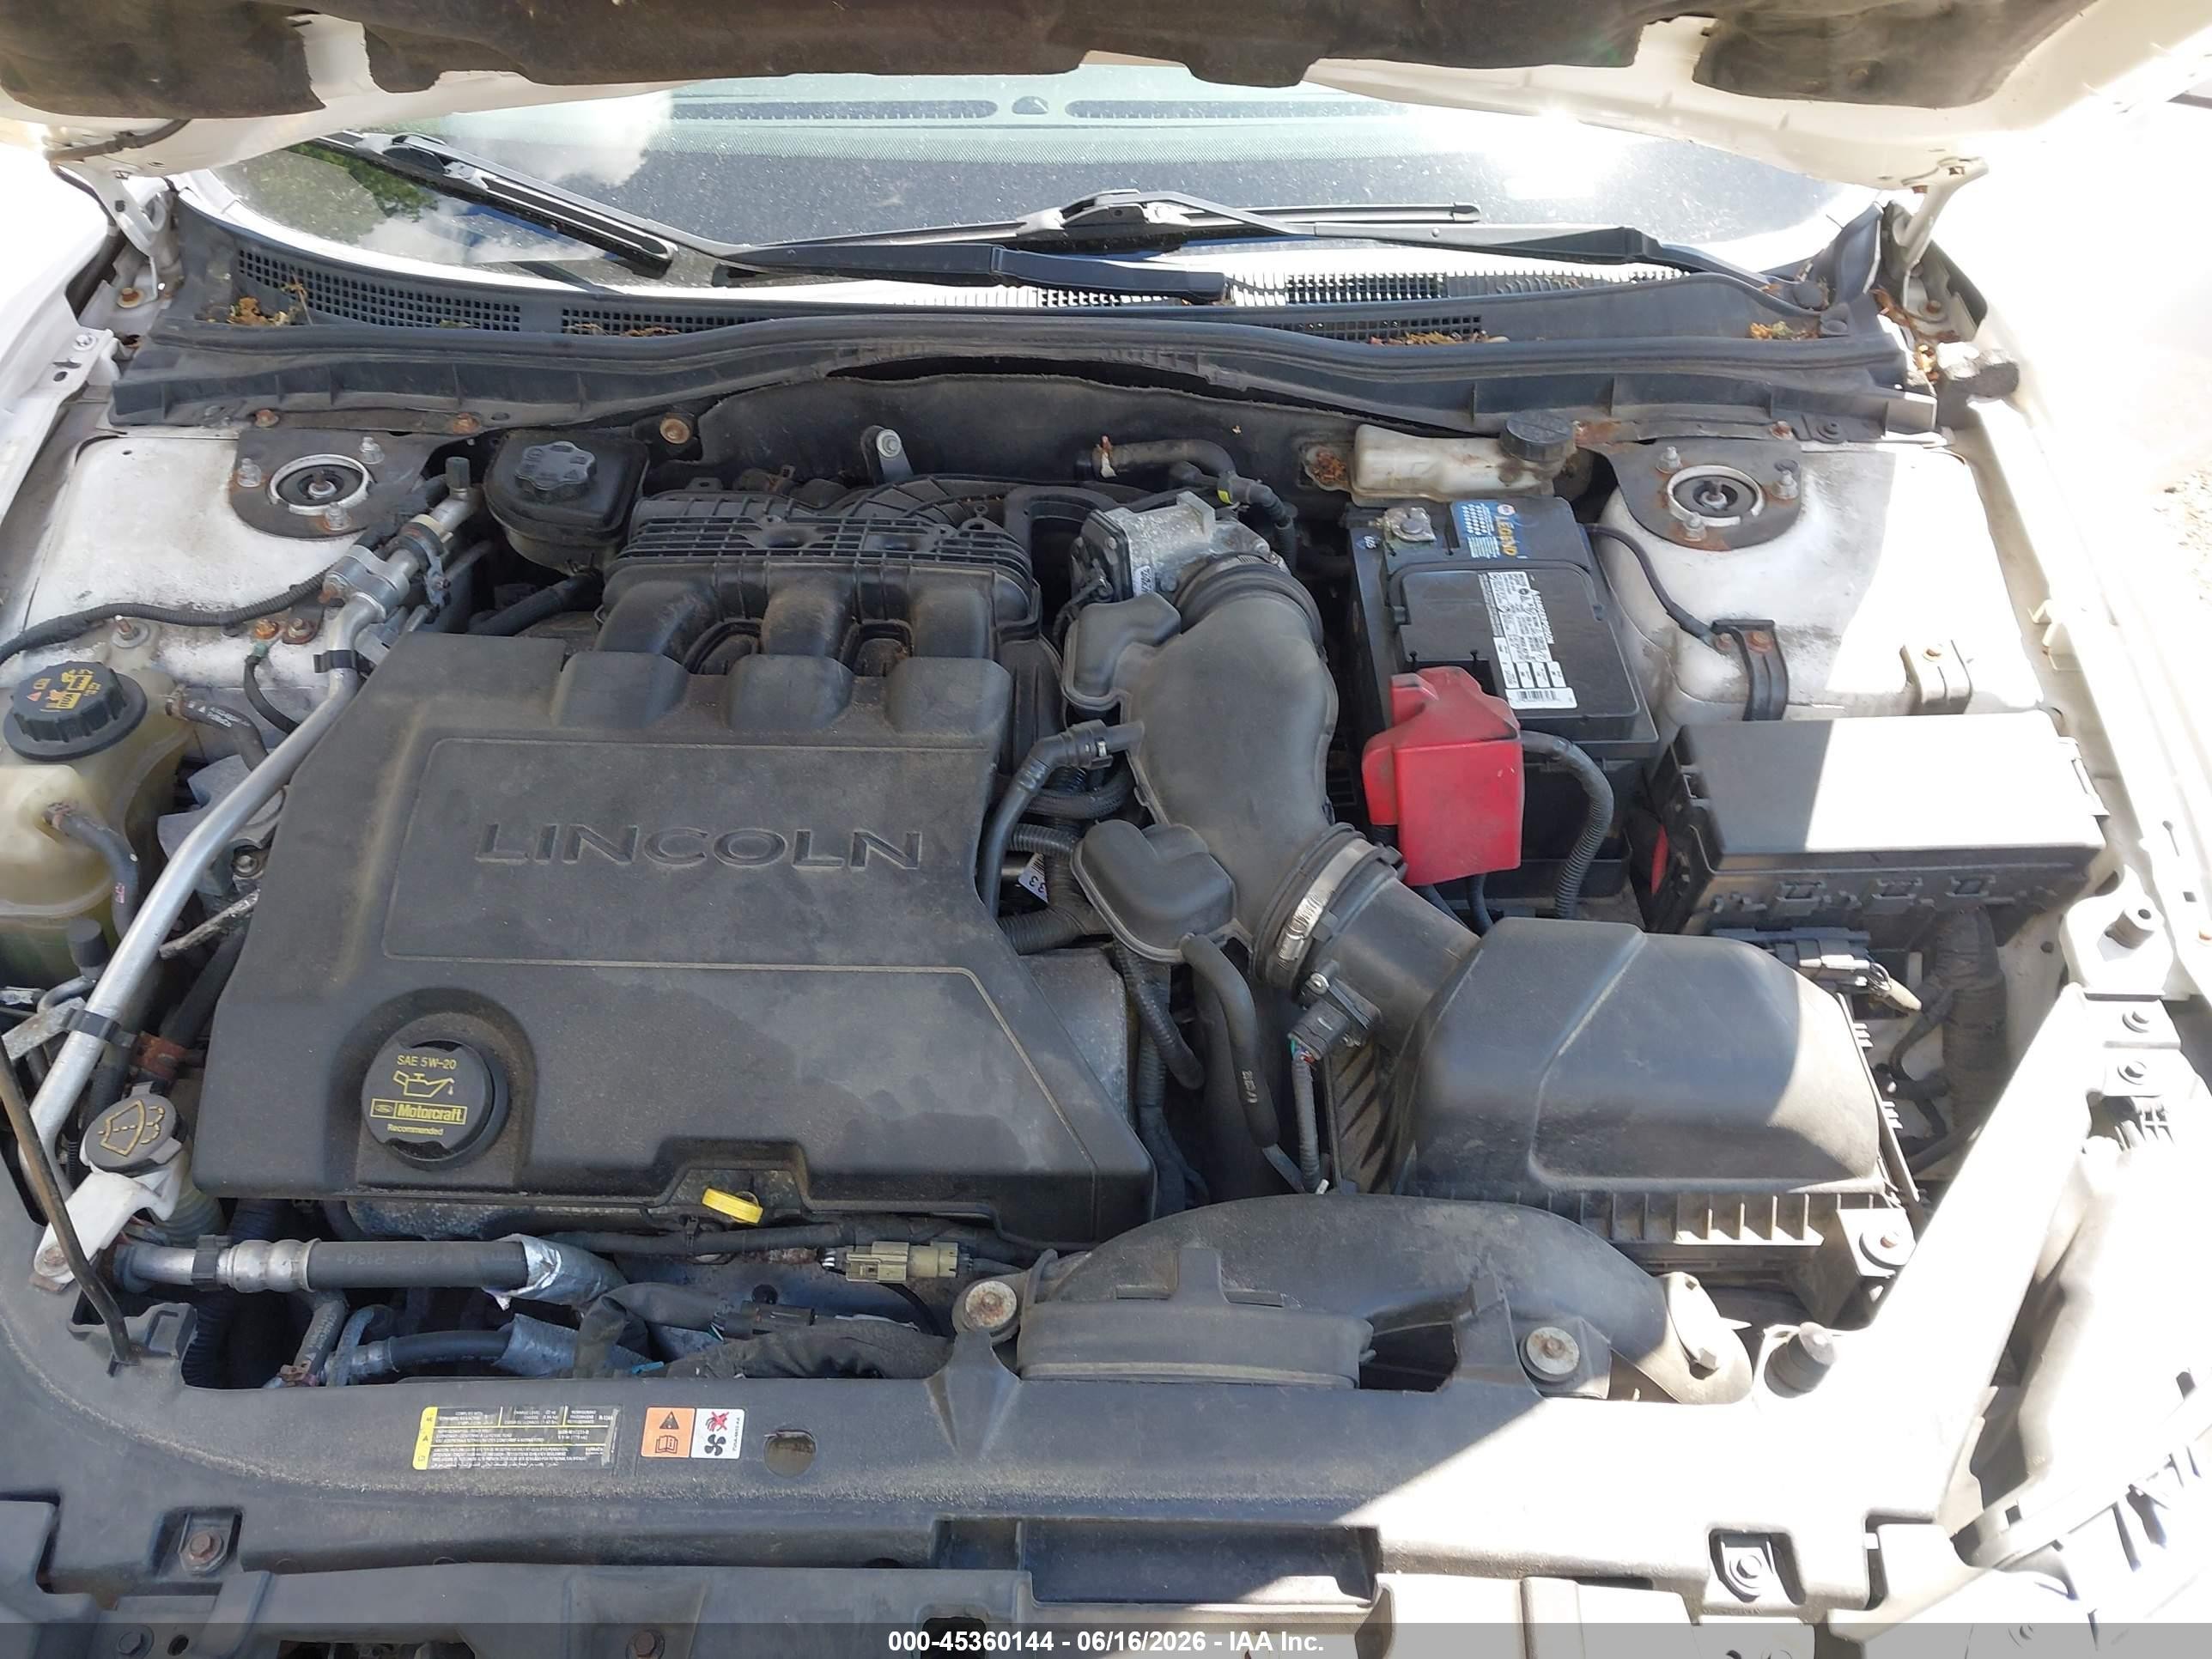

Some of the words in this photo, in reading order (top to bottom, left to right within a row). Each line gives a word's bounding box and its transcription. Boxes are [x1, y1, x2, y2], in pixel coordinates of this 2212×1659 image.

[1494, 516, 1518, 556] LEGEND
[476, 823, 923, 871] LINCOLN
[398, 1054, 418, 1066] SAE
[421, 1057, 457, 1070] 5W-20
[398, 1104, 462, 1121] Motorcraft
[387, 1124, 444, 1135] Recommended
